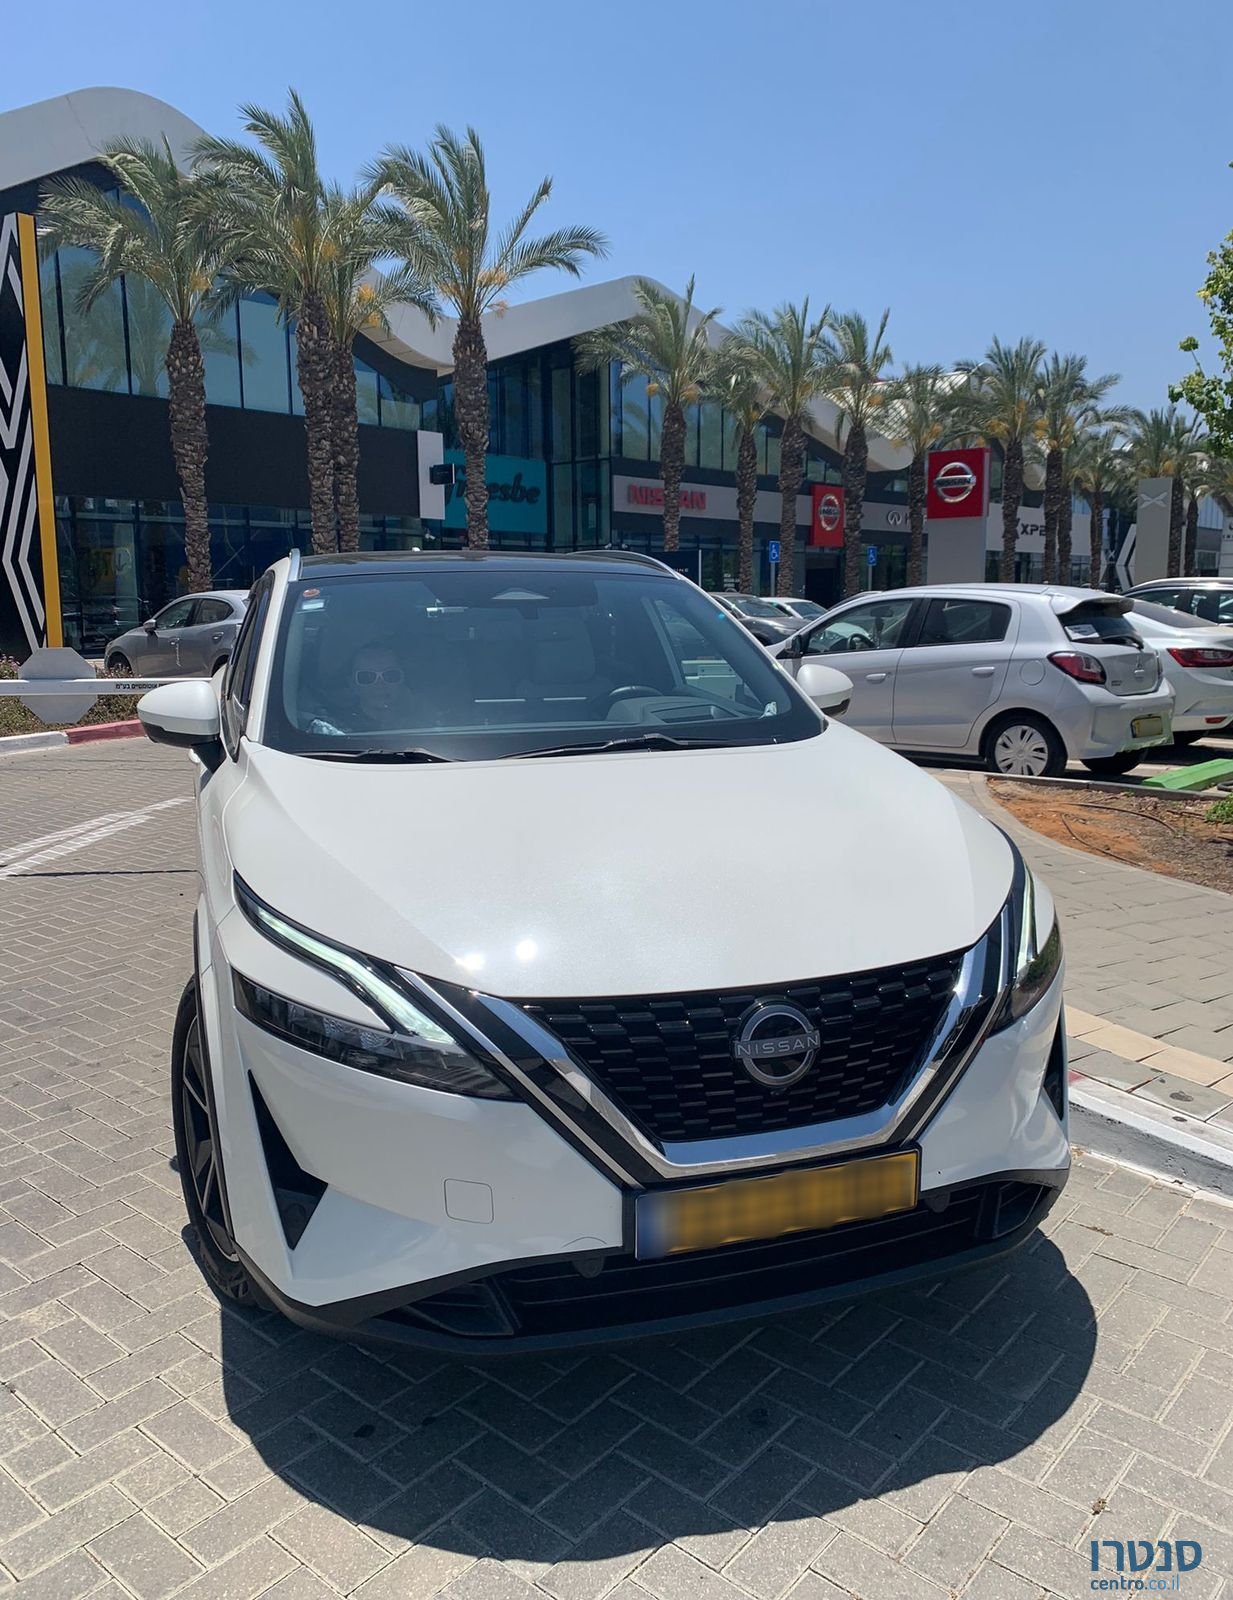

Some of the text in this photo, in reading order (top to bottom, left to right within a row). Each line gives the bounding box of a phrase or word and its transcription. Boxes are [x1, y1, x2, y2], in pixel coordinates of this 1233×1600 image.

[628, 484, 706, 510] NISAN
[1020, 523, 1047, 537] XPE
[736, 1034, 819, 1056] NISSAN
